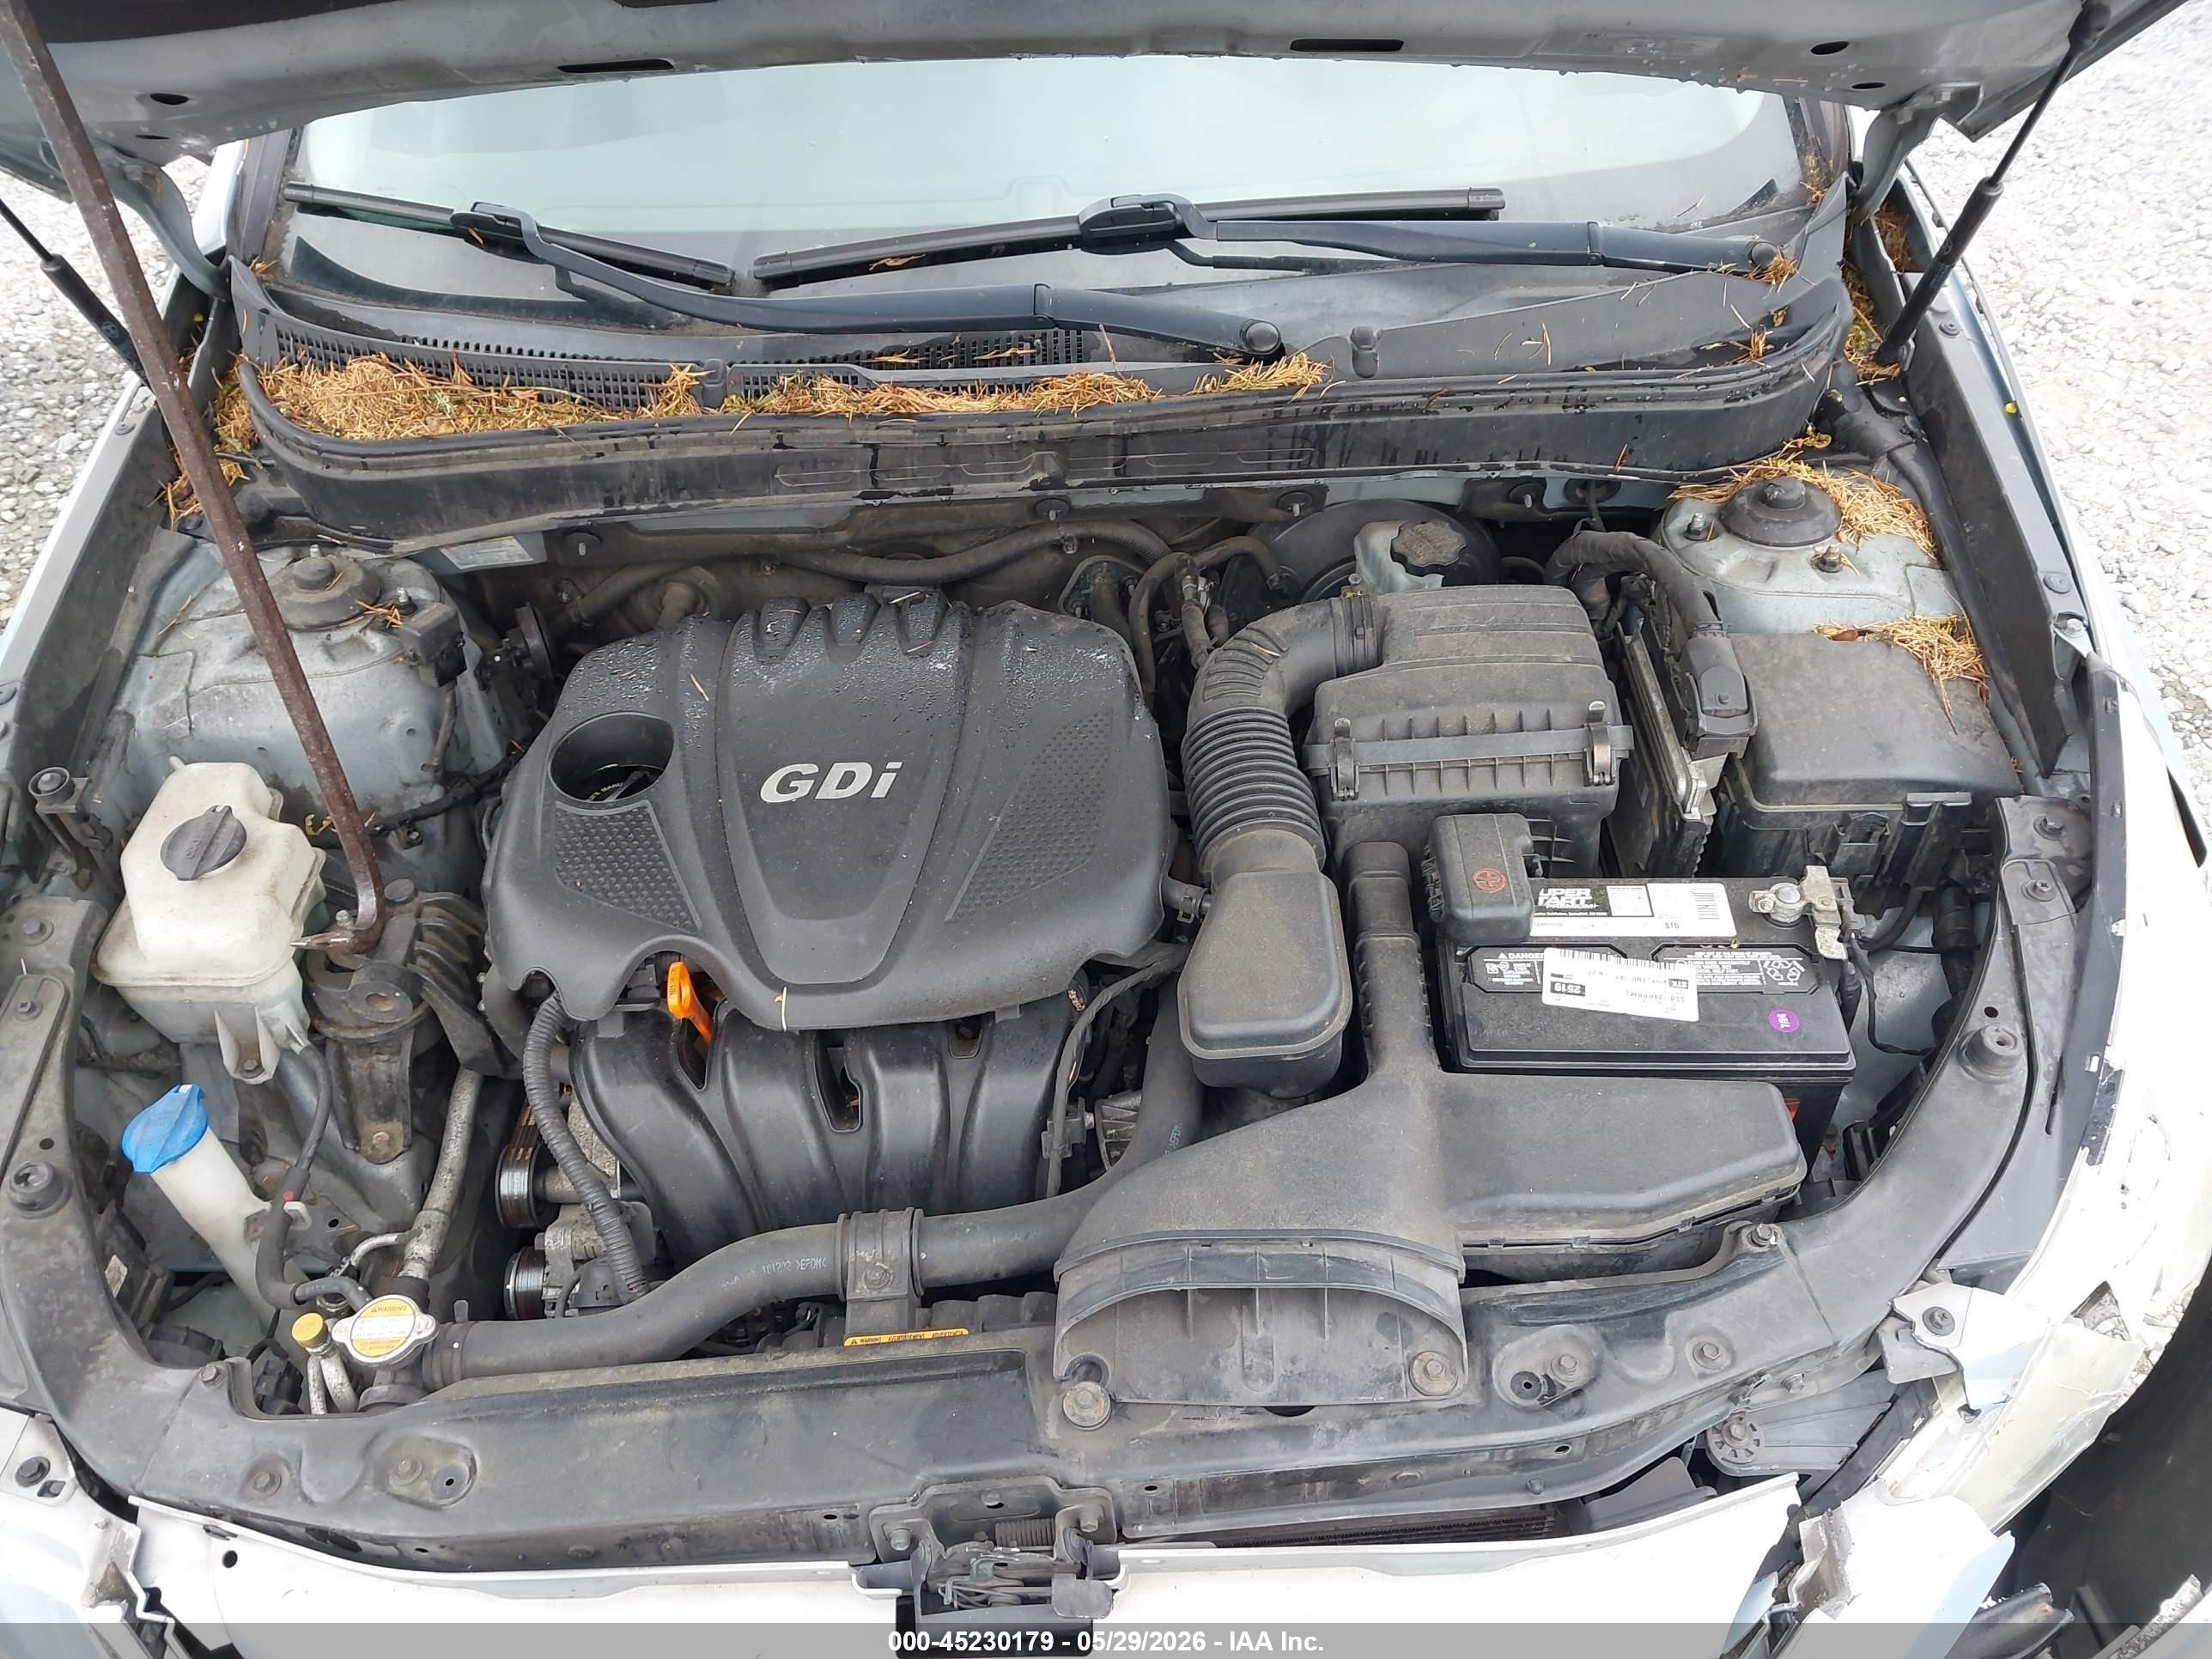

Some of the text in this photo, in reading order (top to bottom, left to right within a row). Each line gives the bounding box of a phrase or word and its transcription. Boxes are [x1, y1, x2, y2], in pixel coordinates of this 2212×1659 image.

[760, 762, 903, 804] GDi
[1539, 888, 1592, 896] UPER
[1554, 982, 1582, 994] 2519
